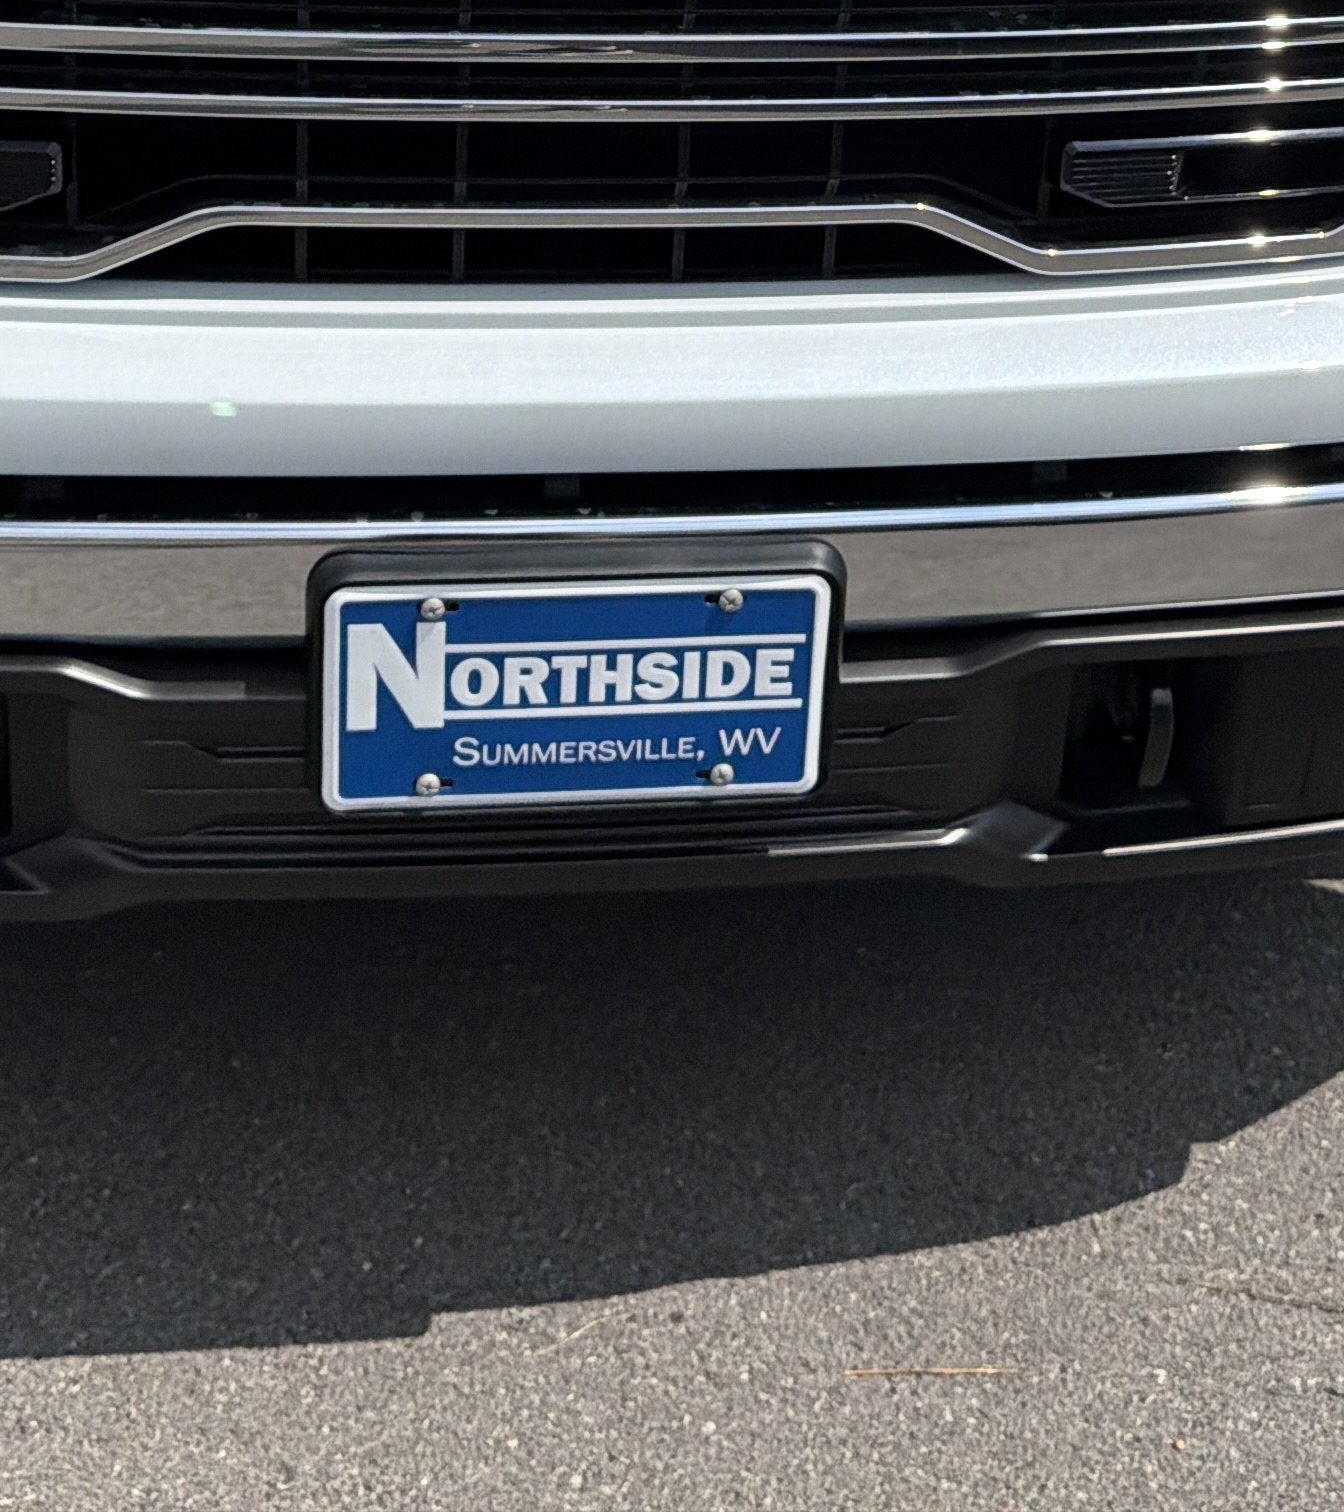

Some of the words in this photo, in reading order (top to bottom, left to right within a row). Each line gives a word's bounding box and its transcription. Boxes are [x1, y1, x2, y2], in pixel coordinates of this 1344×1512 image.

[345, 621, 796, 731] NORTHSIDE
[452, 735, 705, 767] SUMMERSVILLE,
[718, 727, 783, 757] WV
